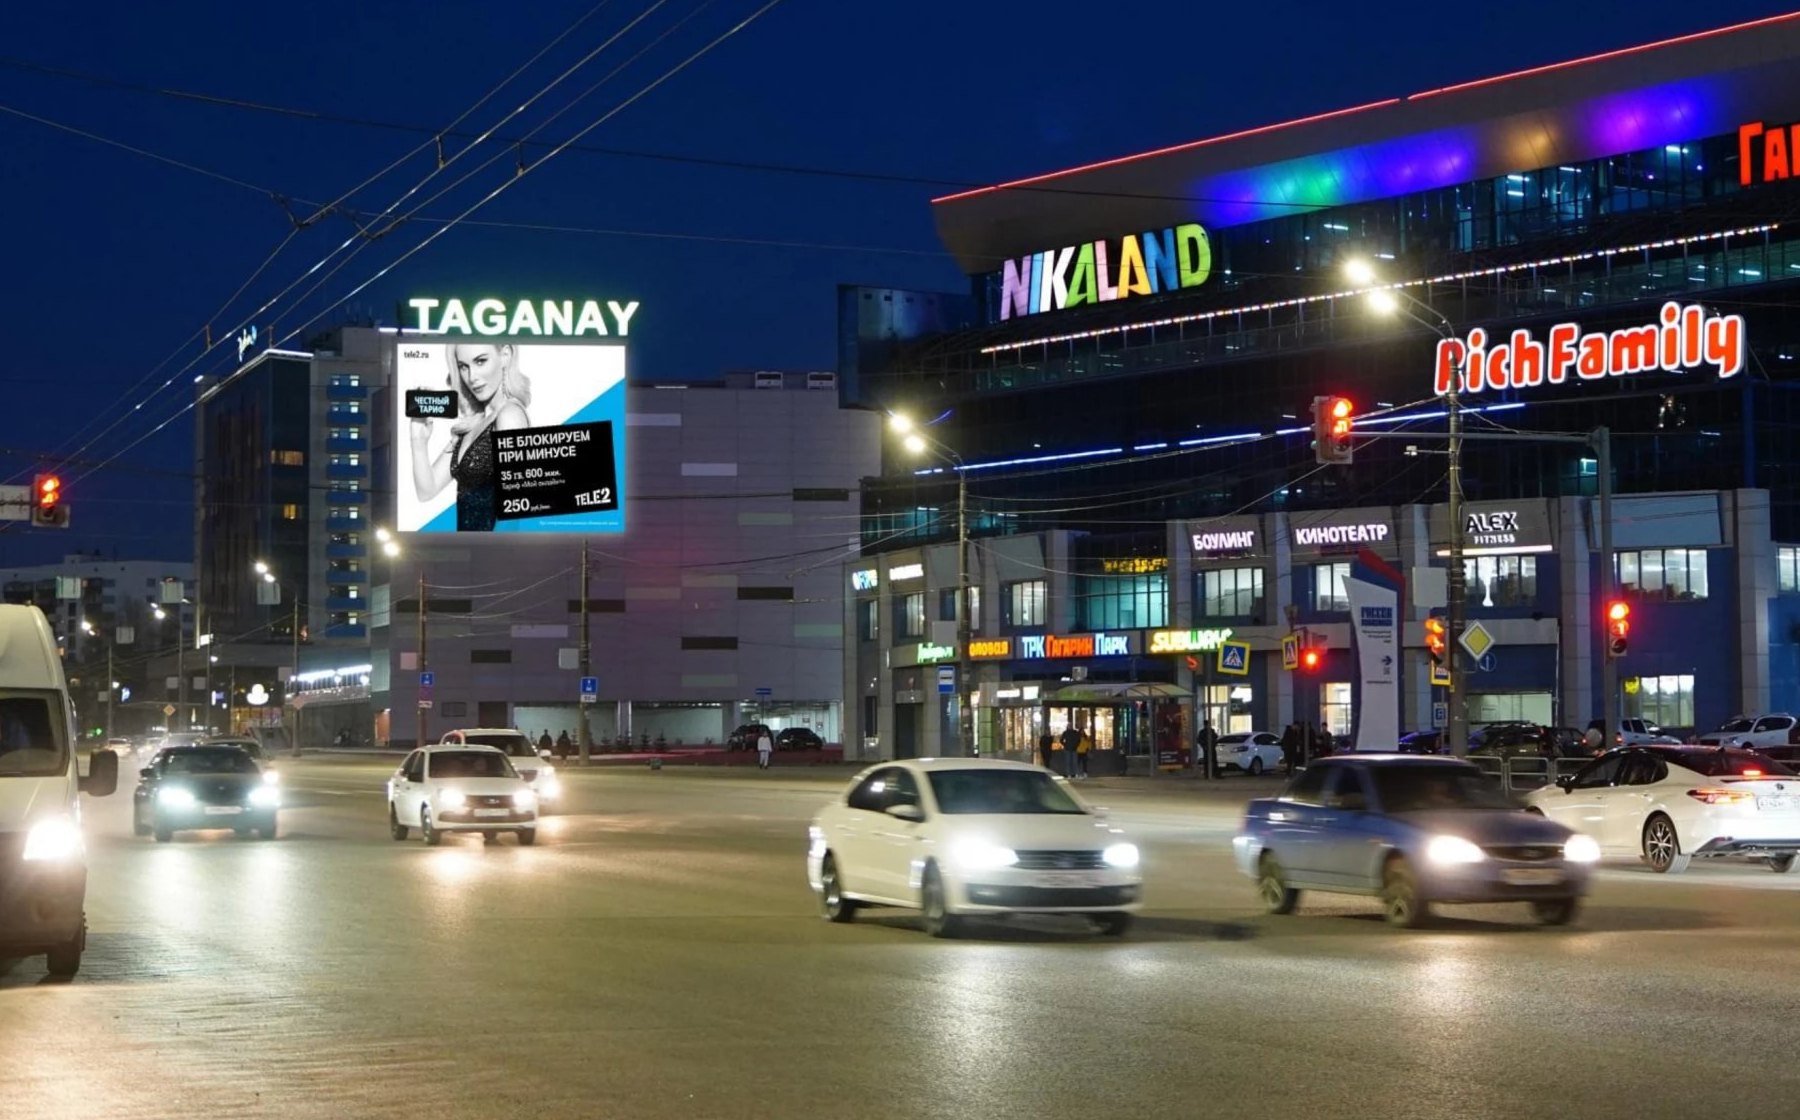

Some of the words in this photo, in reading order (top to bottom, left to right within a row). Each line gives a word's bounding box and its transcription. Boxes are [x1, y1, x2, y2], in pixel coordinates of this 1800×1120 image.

[1000, 223, 1211, 320] NIKALAND
[409, 298, 640, 336] TAGANAY
[404, 350, 429, 359] tele2.ru
[1434, 327, 1544, 395] Rich
[1547, 301, 1746, 384] Family
[414, 395, 450, 406] ЧЕСТНЫЙ
[419, 405, 445, 414] ТАРИФ
[497, 437, 514, 450] НЕ
[516, 430, 591, 447] БЛОКИРУЕМ
[499, 450, 523, 463] ПРИ
[526, 445, 577, 461] МИНУСЕ
[501, 470, 512, 481] 35
[525, 467, 543, 479] 600
[503, 497, 530, 513] 250
[575, 487, 611, 506] TELE2
[1465, 511, 1519, 533] ALEX
[1192, 530, 1254, 551] БОУЛИНГ
[1295, 524, 1388, 545] КИНОТЕАТР
[1474, 534, 1516, 544] FITNESS
[1021, 635, 1045, 659] ТРК
[1150, 627, 1233, 654] SUBWAY
